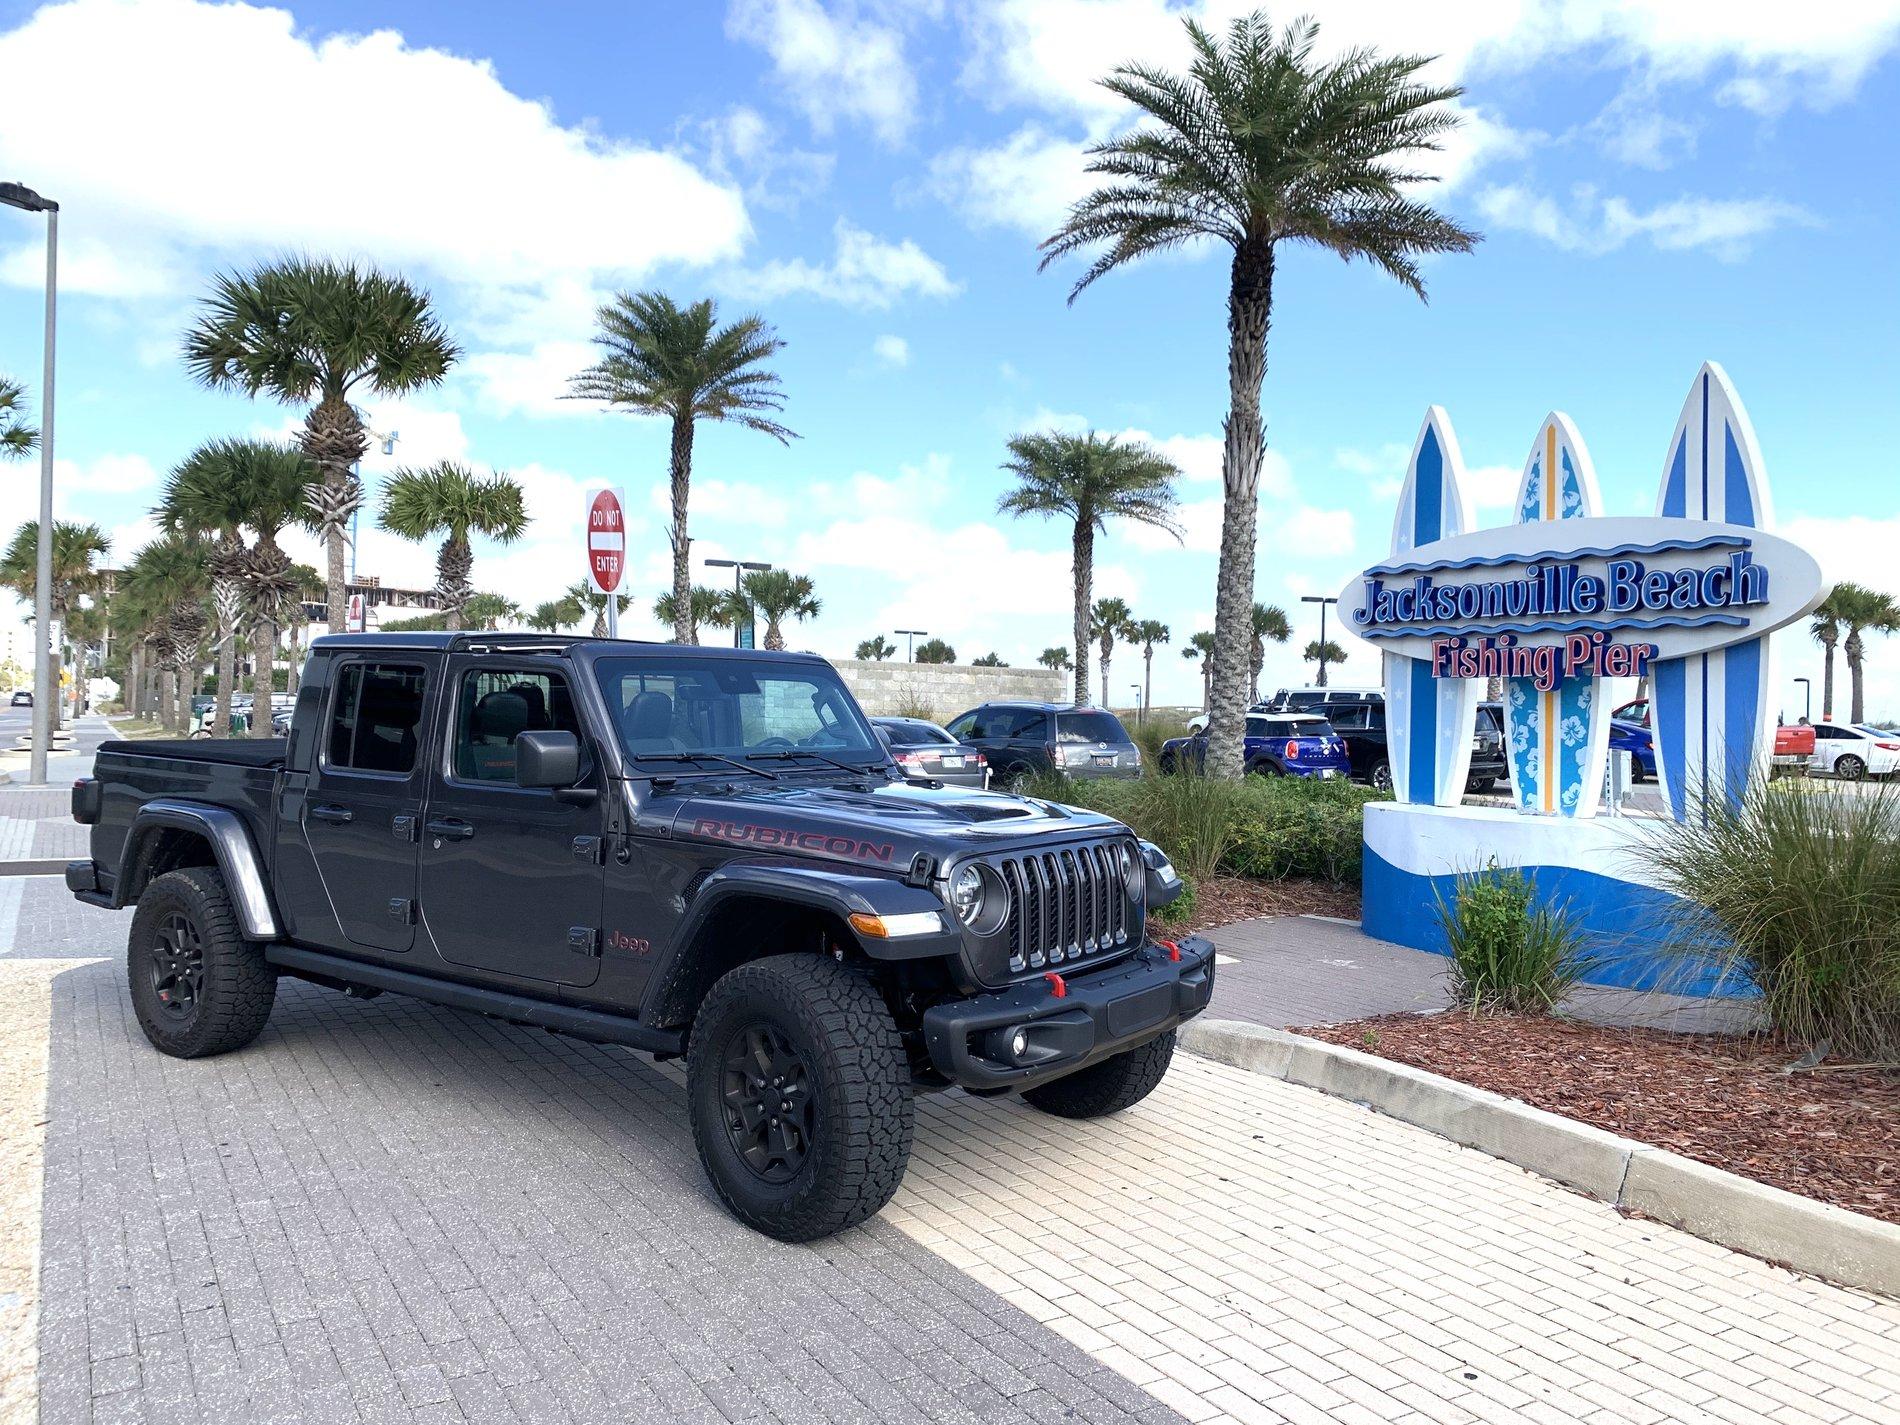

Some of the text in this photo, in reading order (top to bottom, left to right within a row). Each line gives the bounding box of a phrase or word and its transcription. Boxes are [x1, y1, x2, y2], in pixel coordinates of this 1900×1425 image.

[593, 510, 620, 526] DO NOT
[597, 556, 619, 572] ENTER
[1353, 551, 1769, 625] Jacksonville Beach
[1431, 631, 1656, 691] Fishing Pier
[692, 819, 895, 862] RUBICON
[607, 930, 649, 956] Jeep
